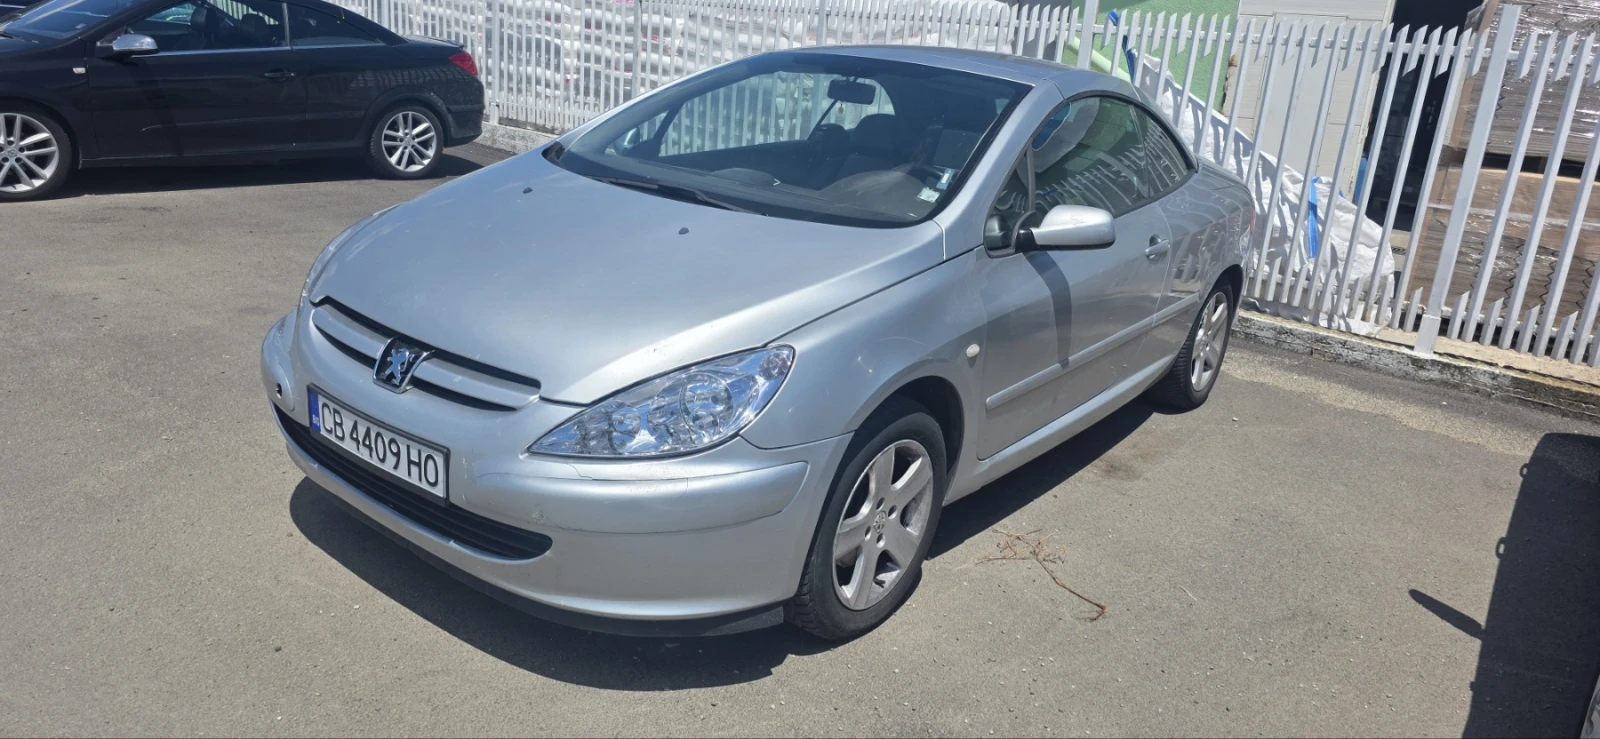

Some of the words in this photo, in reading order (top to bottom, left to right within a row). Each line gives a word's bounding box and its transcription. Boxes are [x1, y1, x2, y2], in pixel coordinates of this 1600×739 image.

[321, 402, 346, 441] CB
[349, 420, 401, 470] 4409
[406, 444, 439, 487] HO
